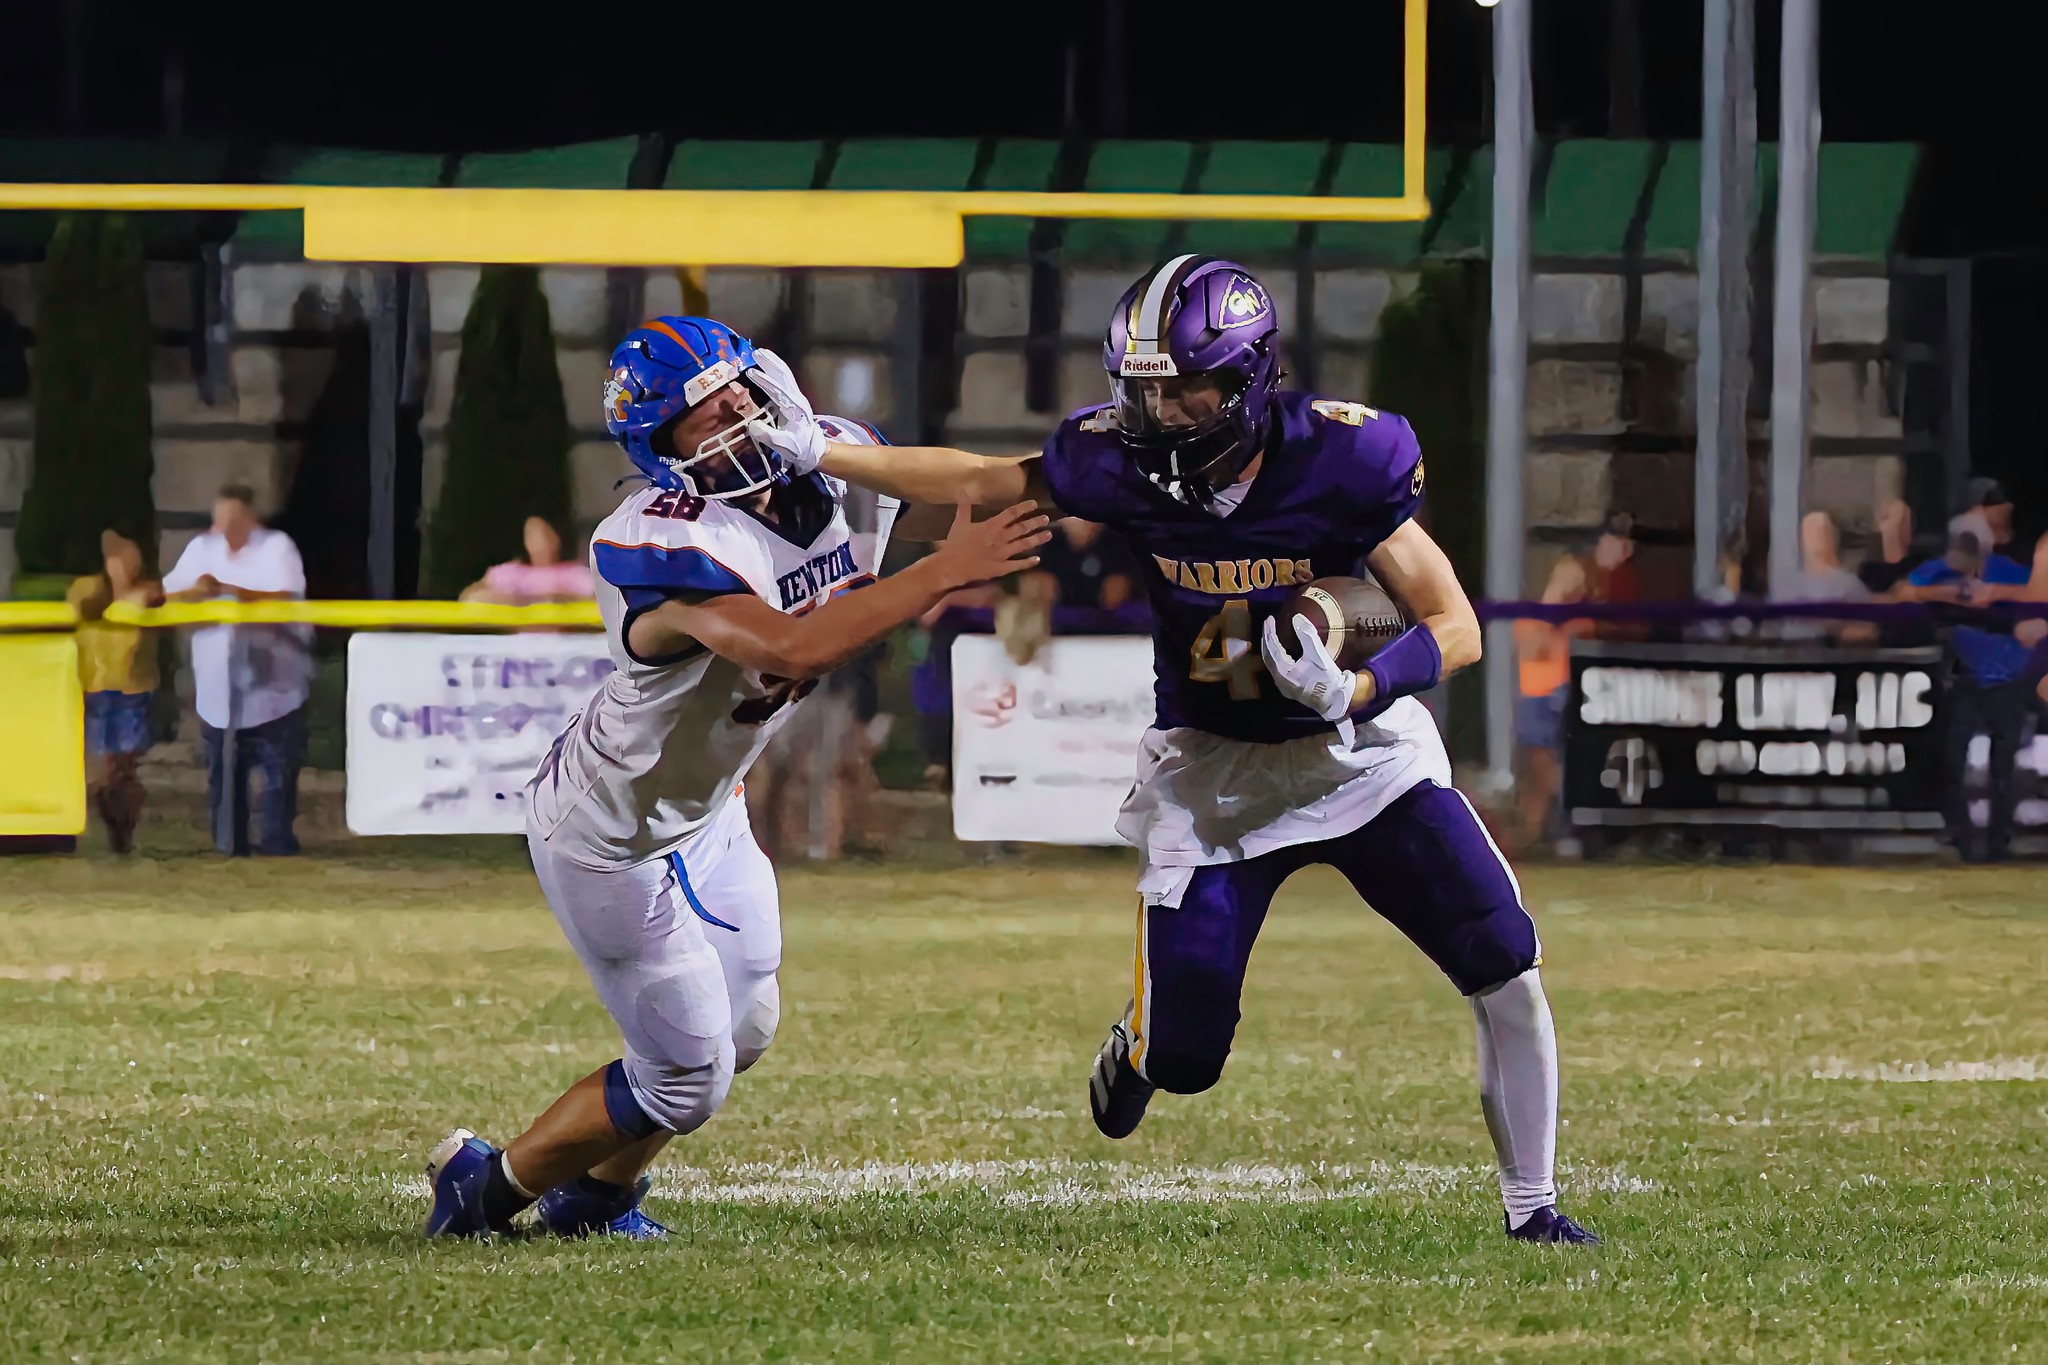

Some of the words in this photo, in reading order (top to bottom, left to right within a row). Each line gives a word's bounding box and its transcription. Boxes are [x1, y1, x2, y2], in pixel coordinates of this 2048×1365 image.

[1124, 359, 1169, 371] Riddell
[776, 541, 859, 610] NEWTON
[1151, 552, 1314, 595] WARRIORS
[1189, 599, 1262, 700] 4
